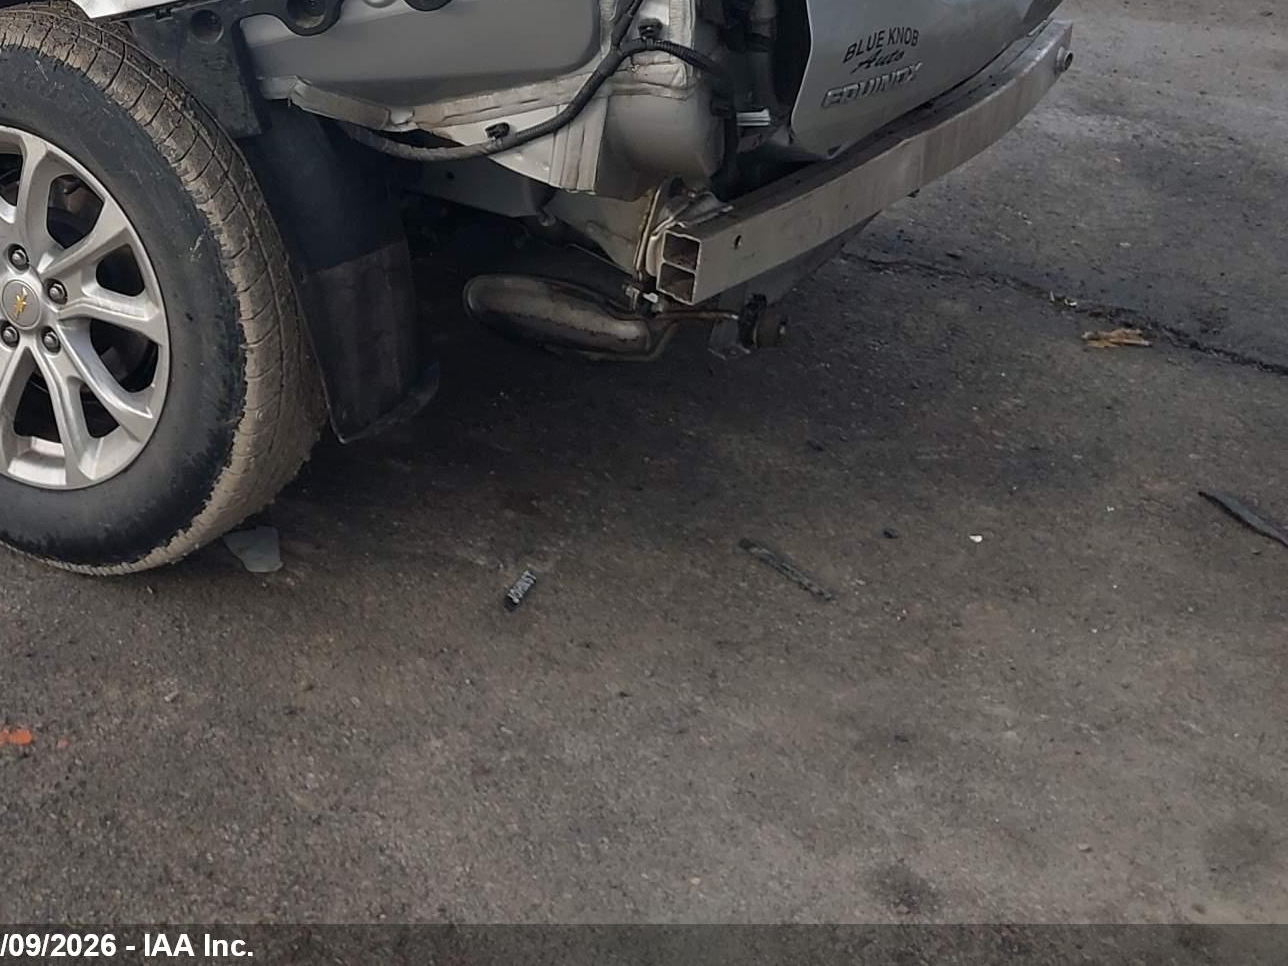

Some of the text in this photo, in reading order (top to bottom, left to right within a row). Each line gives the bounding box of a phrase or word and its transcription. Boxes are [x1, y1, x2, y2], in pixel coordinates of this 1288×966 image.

[842, 26, 921, 64] BLUE KNOB
[850, 48, 905, 74] Auto
[821, 62, 923, 107] EQUINOX
